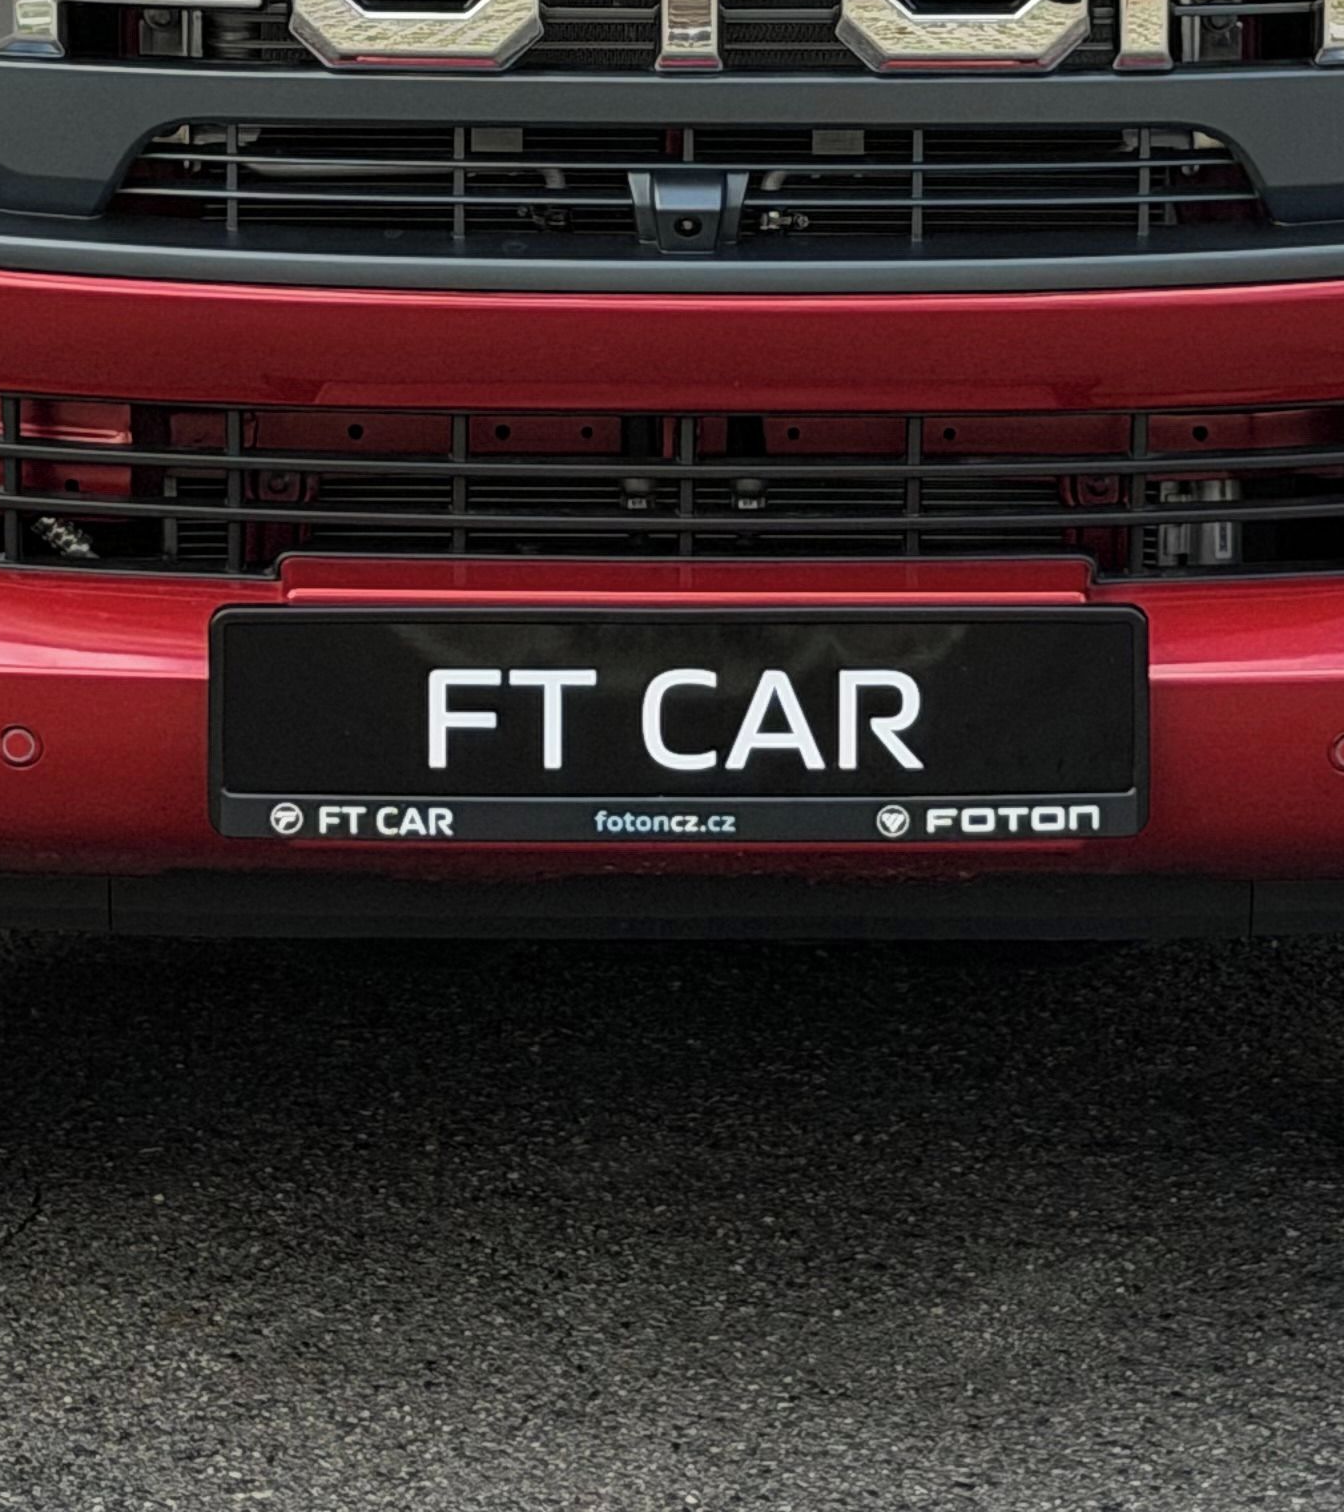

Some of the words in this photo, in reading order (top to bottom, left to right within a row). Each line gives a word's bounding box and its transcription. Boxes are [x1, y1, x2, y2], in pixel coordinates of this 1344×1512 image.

[428, 669, 597, 770] FT
[642, 668, 924, 771] CAR
[318, 805, 368, 835] FT
[375, 805, 454, 837] CAR
[594, 809, 737, 833] fotoncz.cz
[925, 804, 1100, 834] FOTON
